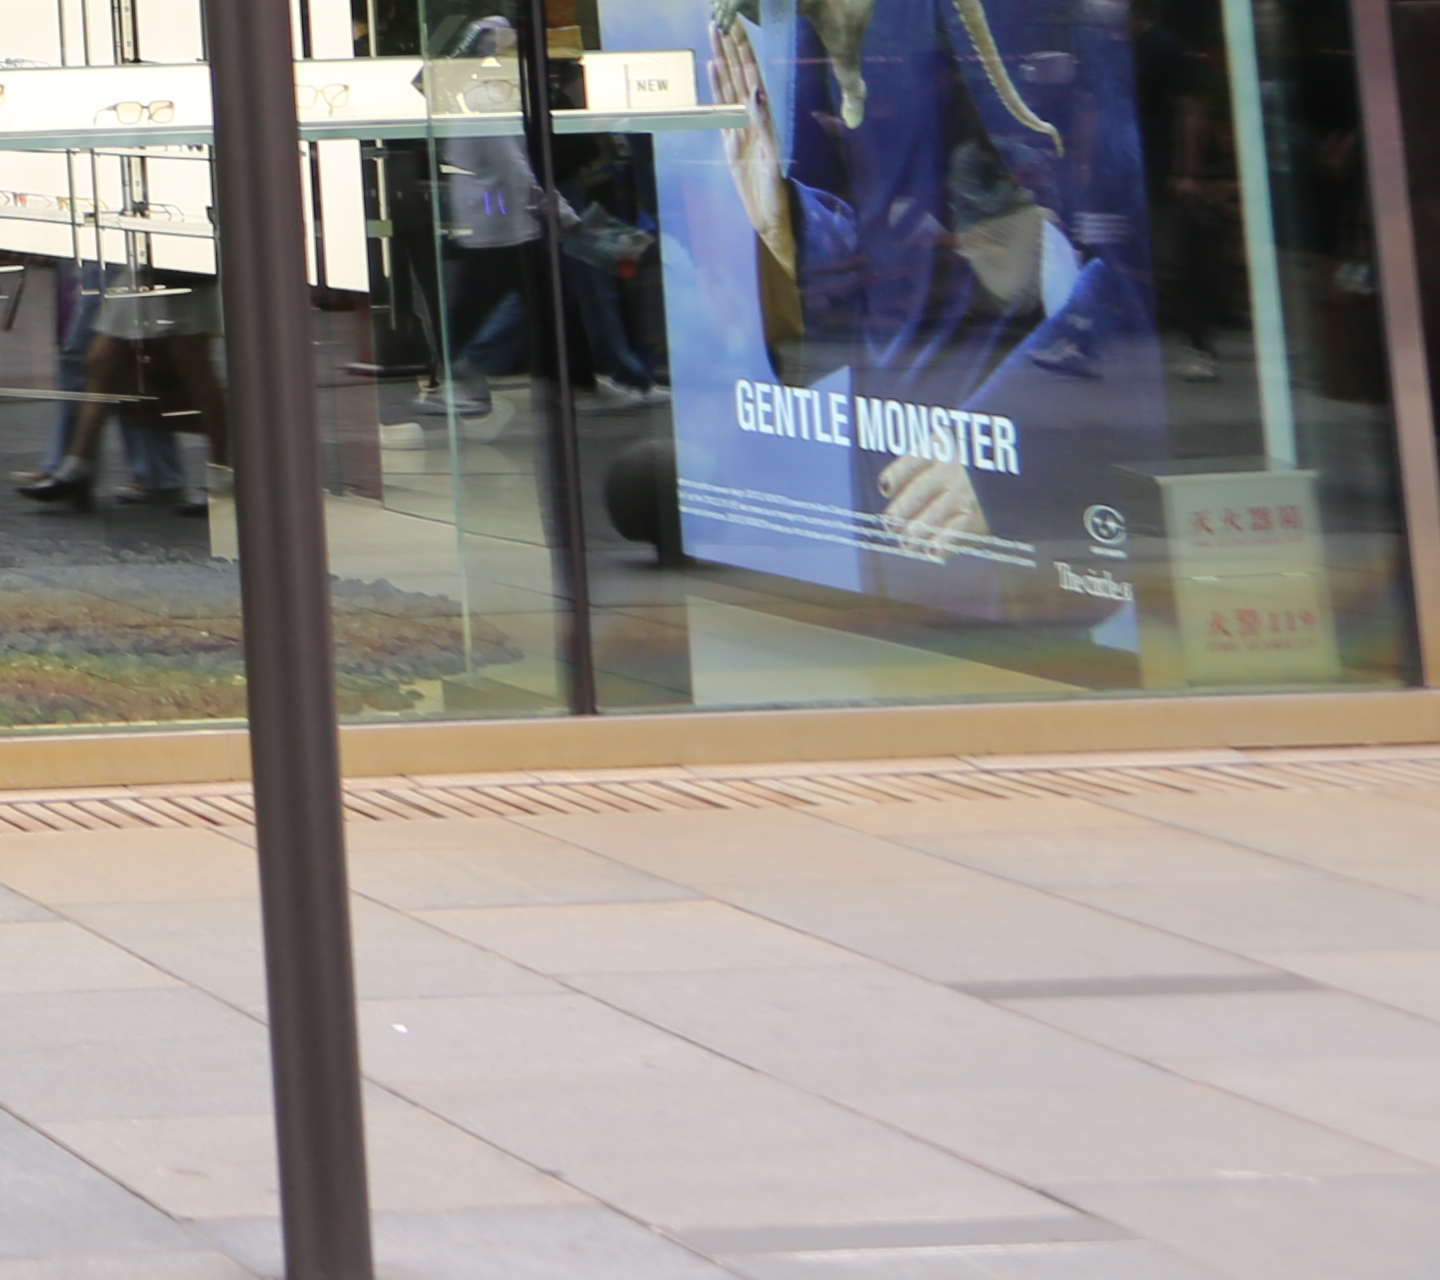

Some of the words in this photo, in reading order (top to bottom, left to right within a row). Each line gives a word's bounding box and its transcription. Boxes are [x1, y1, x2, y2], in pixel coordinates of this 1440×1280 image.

[636, 78, 669, 92] NEW
[734, 378, 852, 448] GENTLE
[853, 394, 1021, 476] MONSTER
